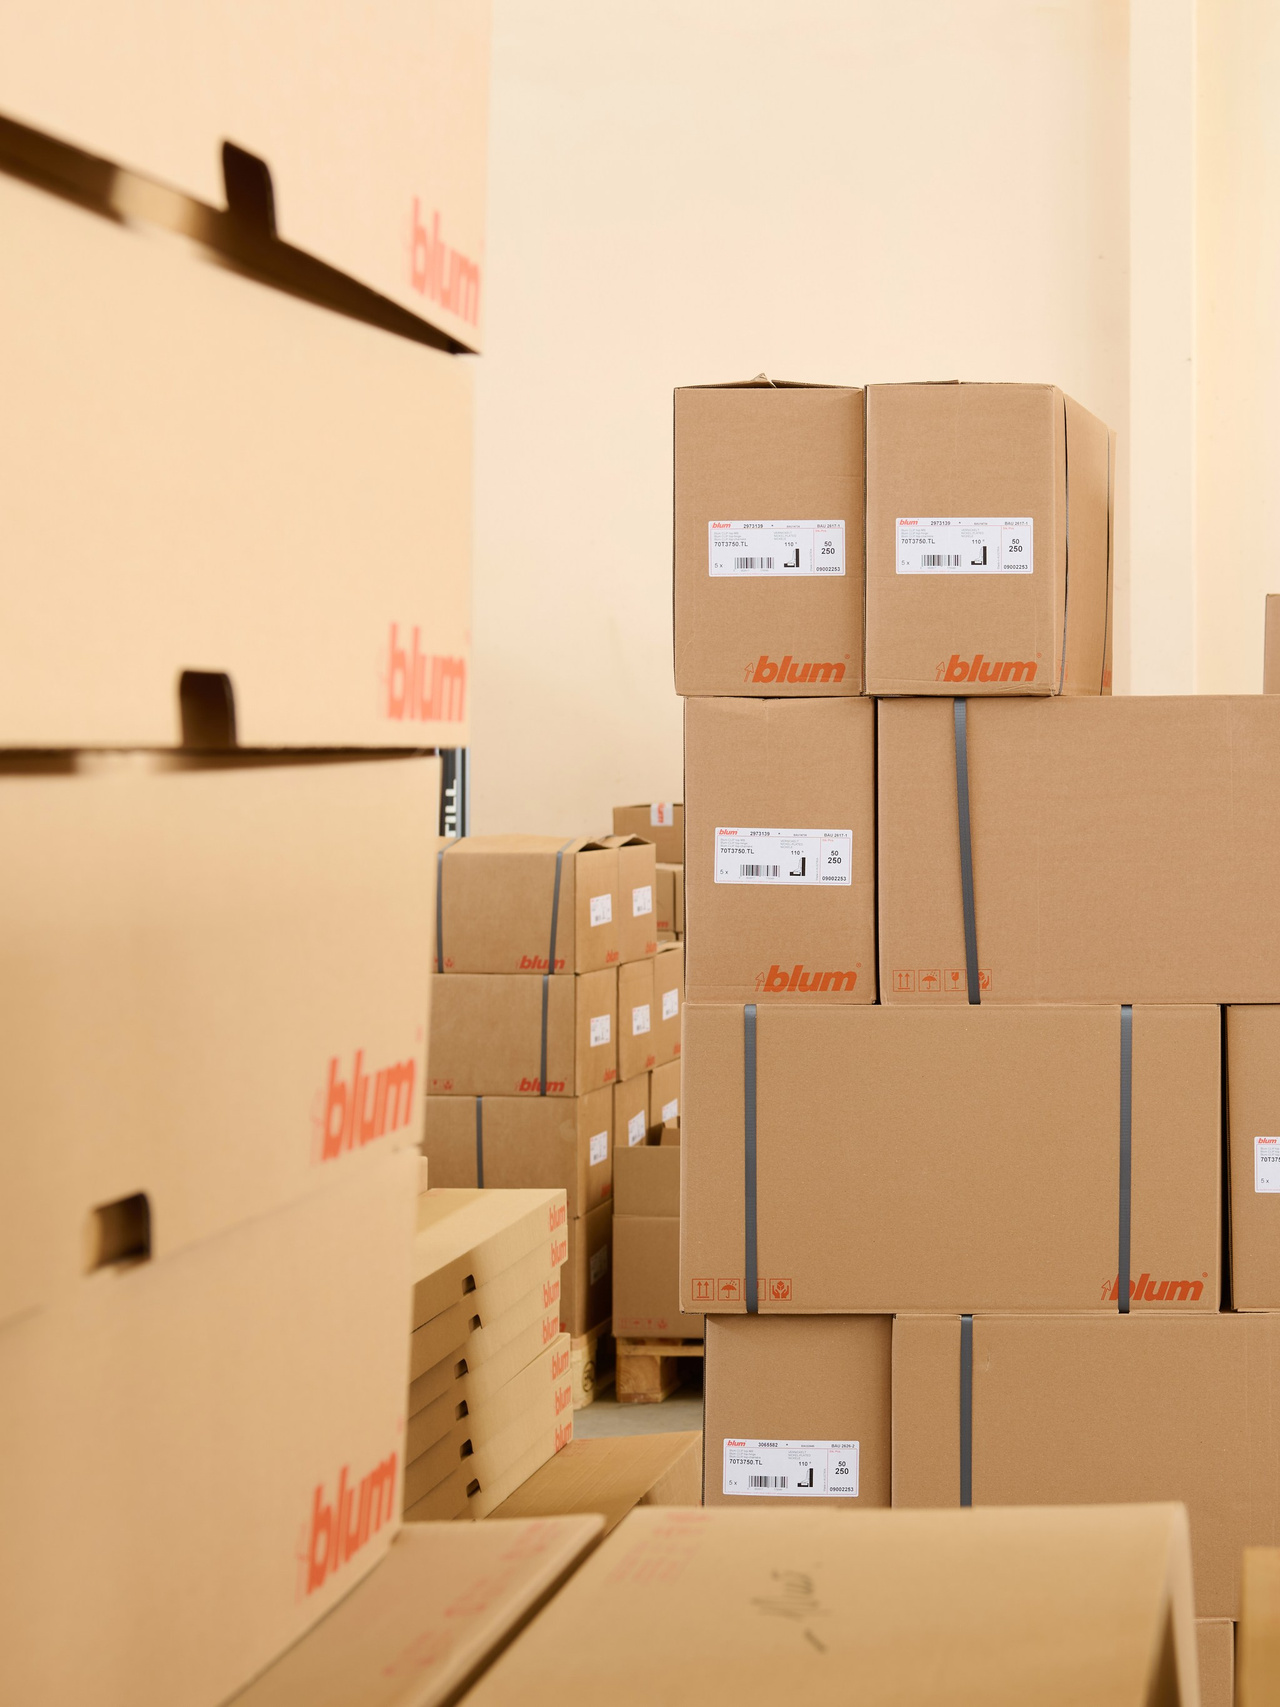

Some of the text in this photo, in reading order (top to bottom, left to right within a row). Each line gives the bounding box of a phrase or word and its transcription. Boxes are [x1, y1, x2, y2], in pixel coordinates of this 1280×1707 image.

[410, 196, 481, 327] blum
[821, 547, 836, 555] 250
[1008, 545, 1023, 553] 250
[386, 622, 467, 723] blum
[752, 656, 846, 684] blum
[943, 655, 1038, 683] blum
[763, 965, 858, 993] blum
[321, 1049, 416, 1161] blum
[835, 1467, 849, 1475] 250
[306, 1452, 398, 1595] blum
